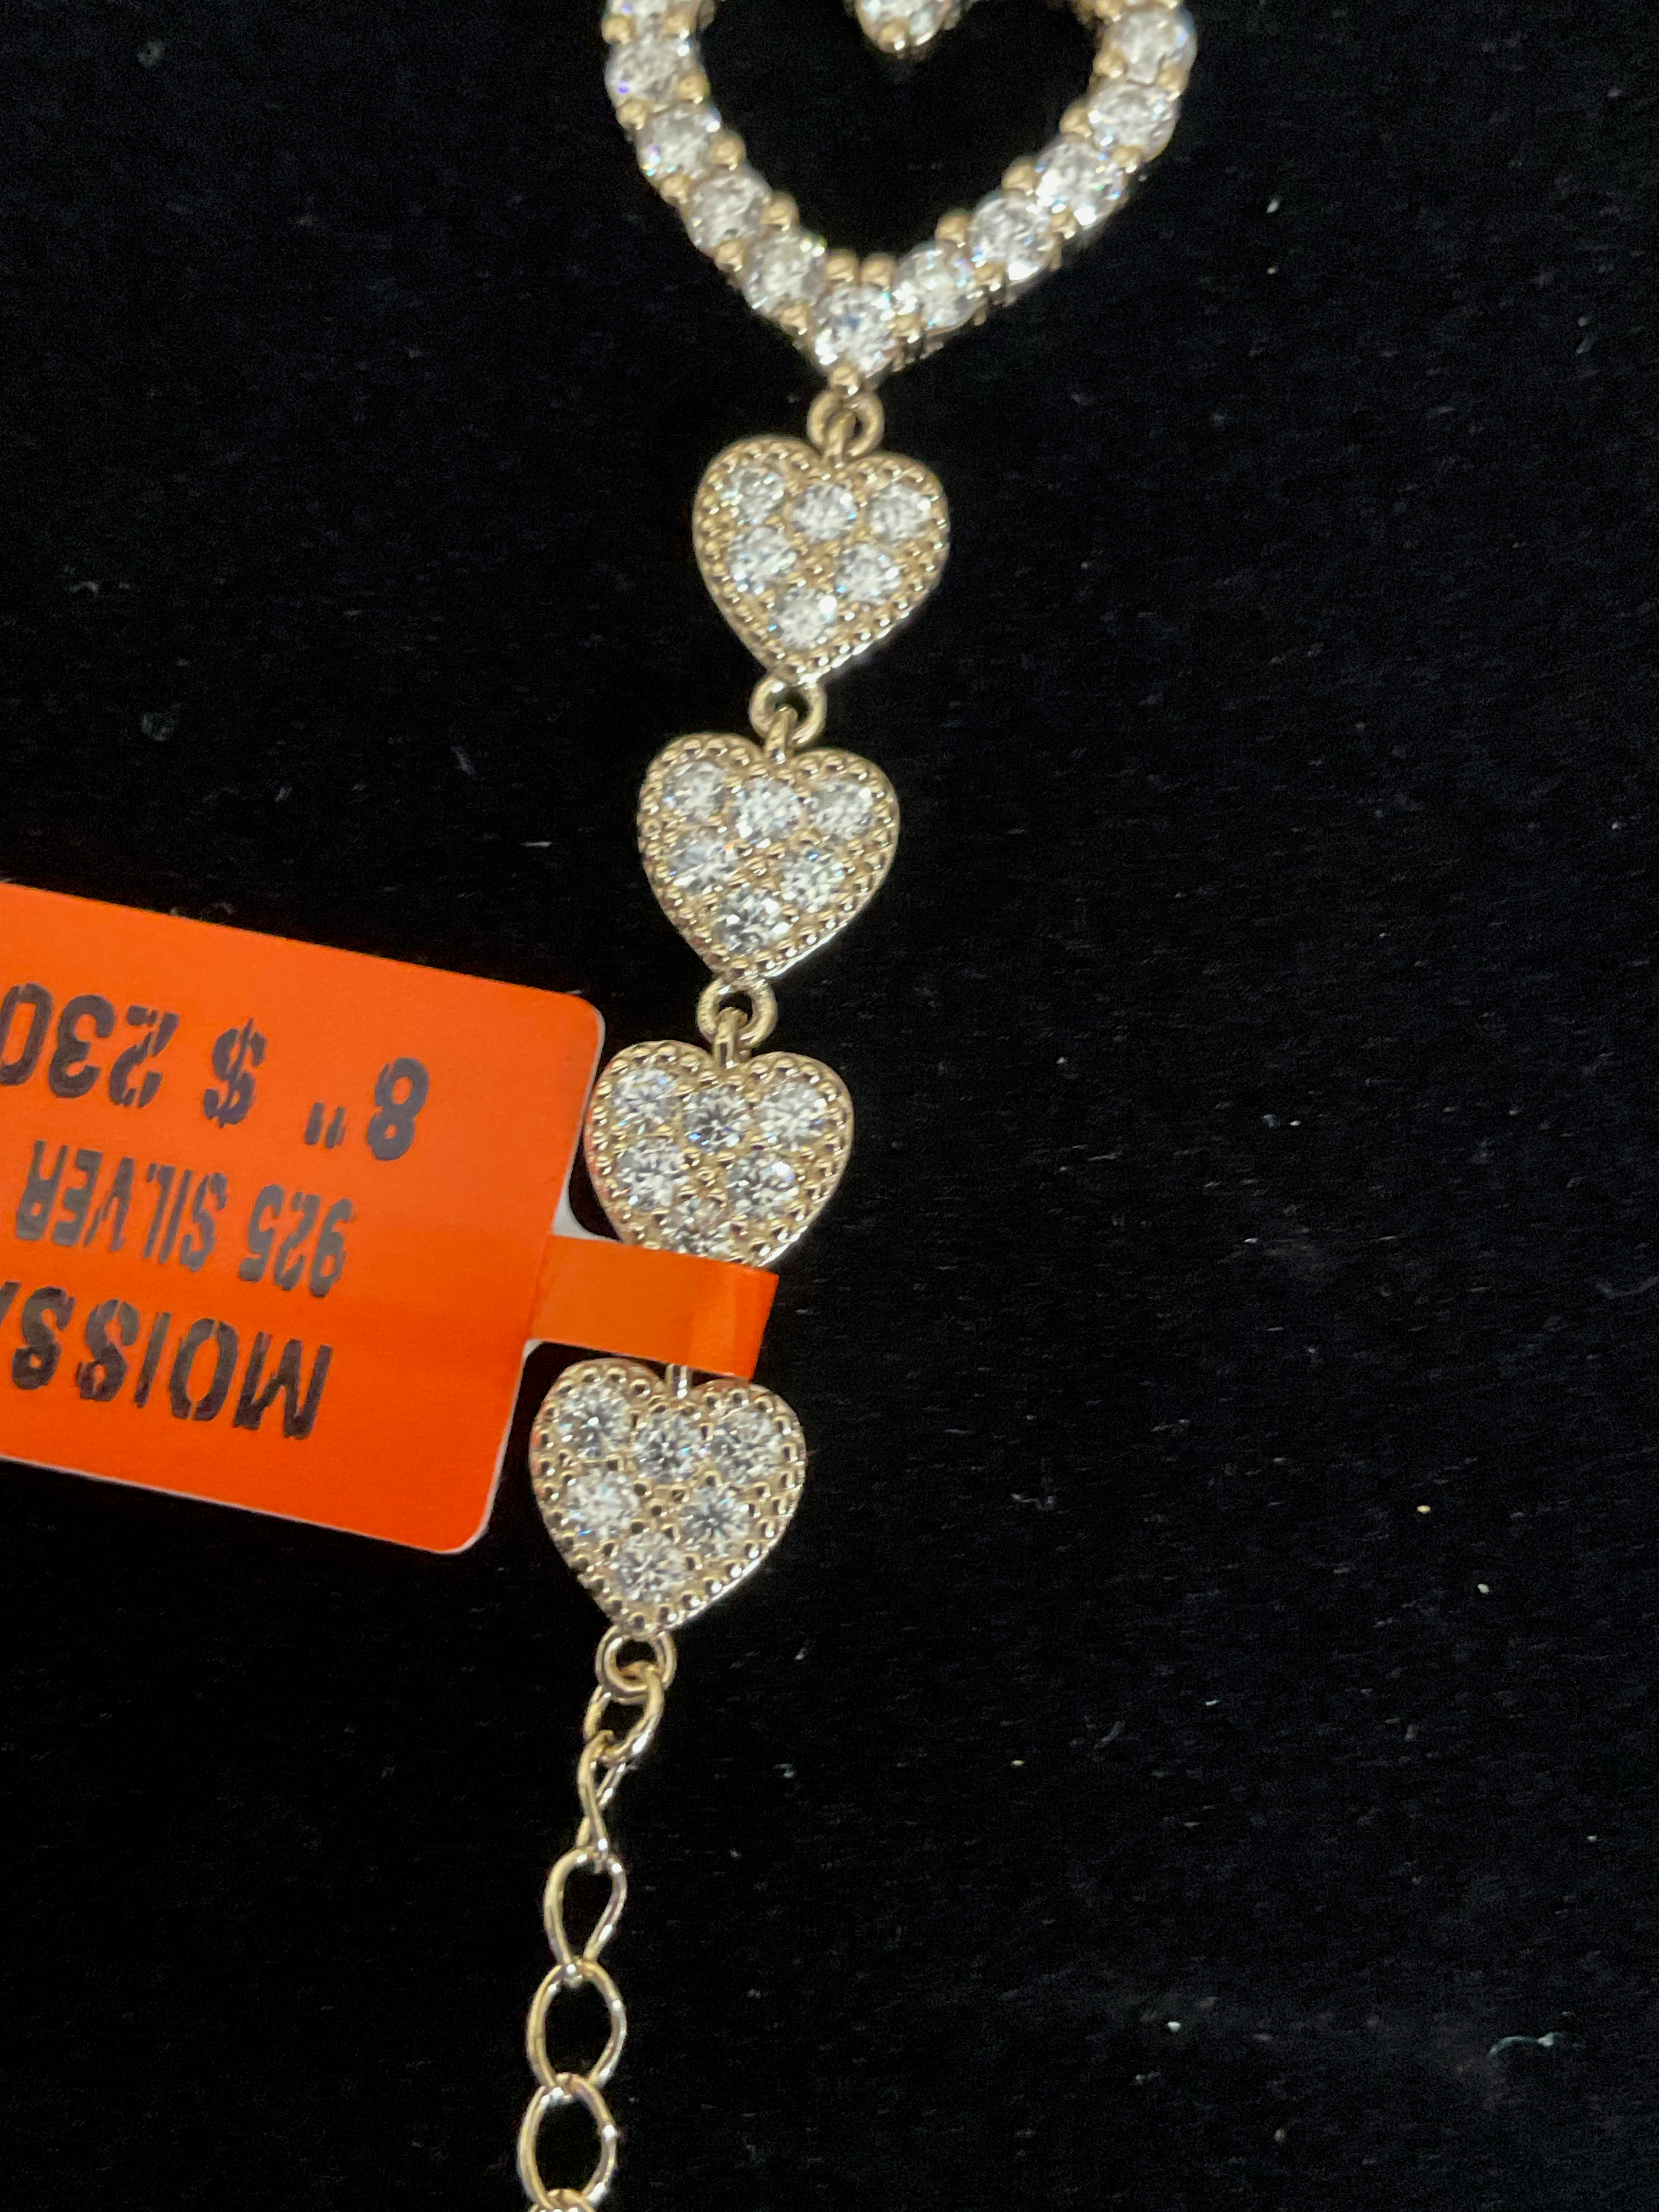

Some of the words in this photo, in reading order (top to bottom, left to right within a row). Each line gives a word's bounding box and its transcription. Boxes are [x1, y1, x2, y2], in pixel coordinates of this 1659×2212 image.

[0, 983, 179, 1108] 230
[304, 1057, 429, 1161] 8"
[15, 1140, 227, 1272] SILVER
[238, 1184, 357, 1298] 925
